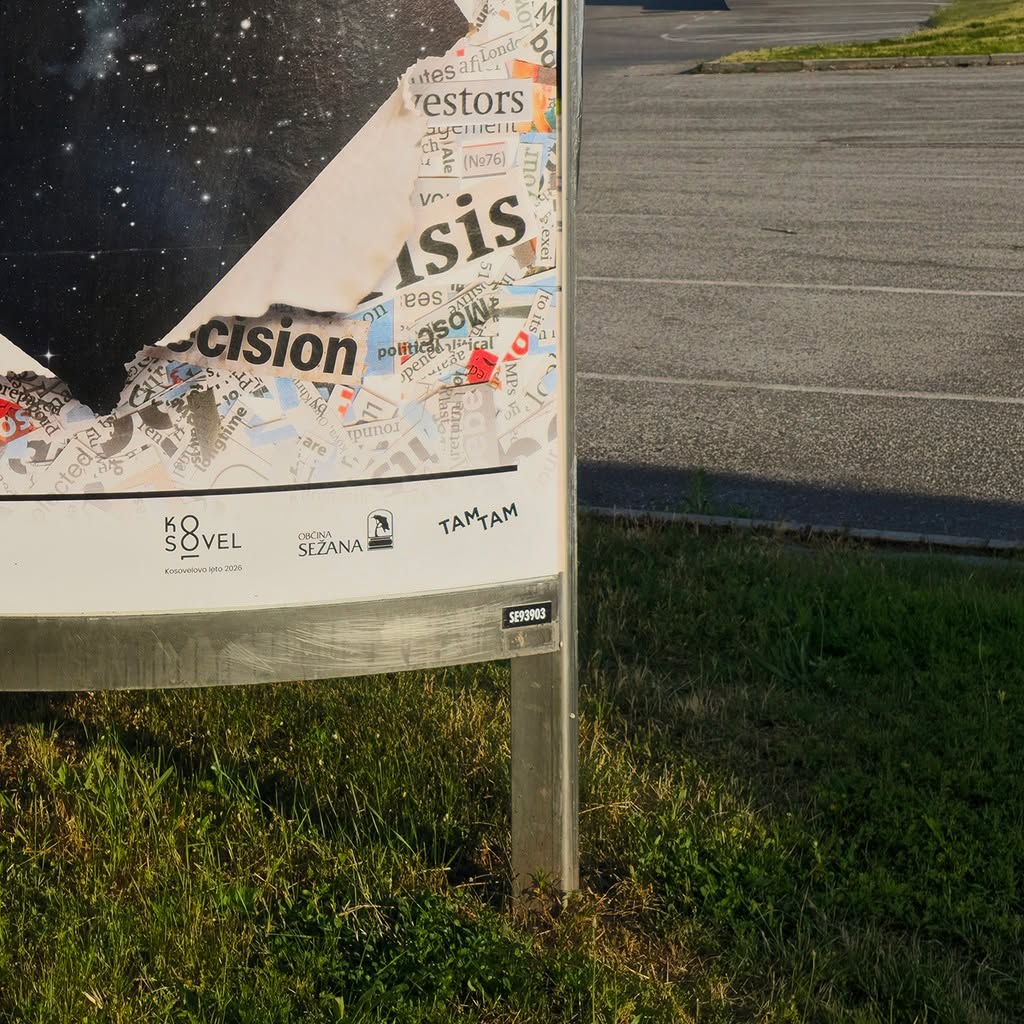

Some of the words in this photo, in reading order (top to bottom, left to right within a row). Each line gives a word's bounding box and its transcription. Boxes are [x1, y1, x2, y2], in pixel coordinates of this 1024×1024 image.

[362, 303, 387, 325] on
[378, 338, 440, 361] political
[505, 362, 518, 396] MPs
[298, 530, 332, 541] OBČINA
[298, 538, 363, 557] SEŽANA
[164, 565, 207, 576] Kosovelovo
[224, 564, 243, 573] 2026
[508, 606, 547, 625] SE93903
